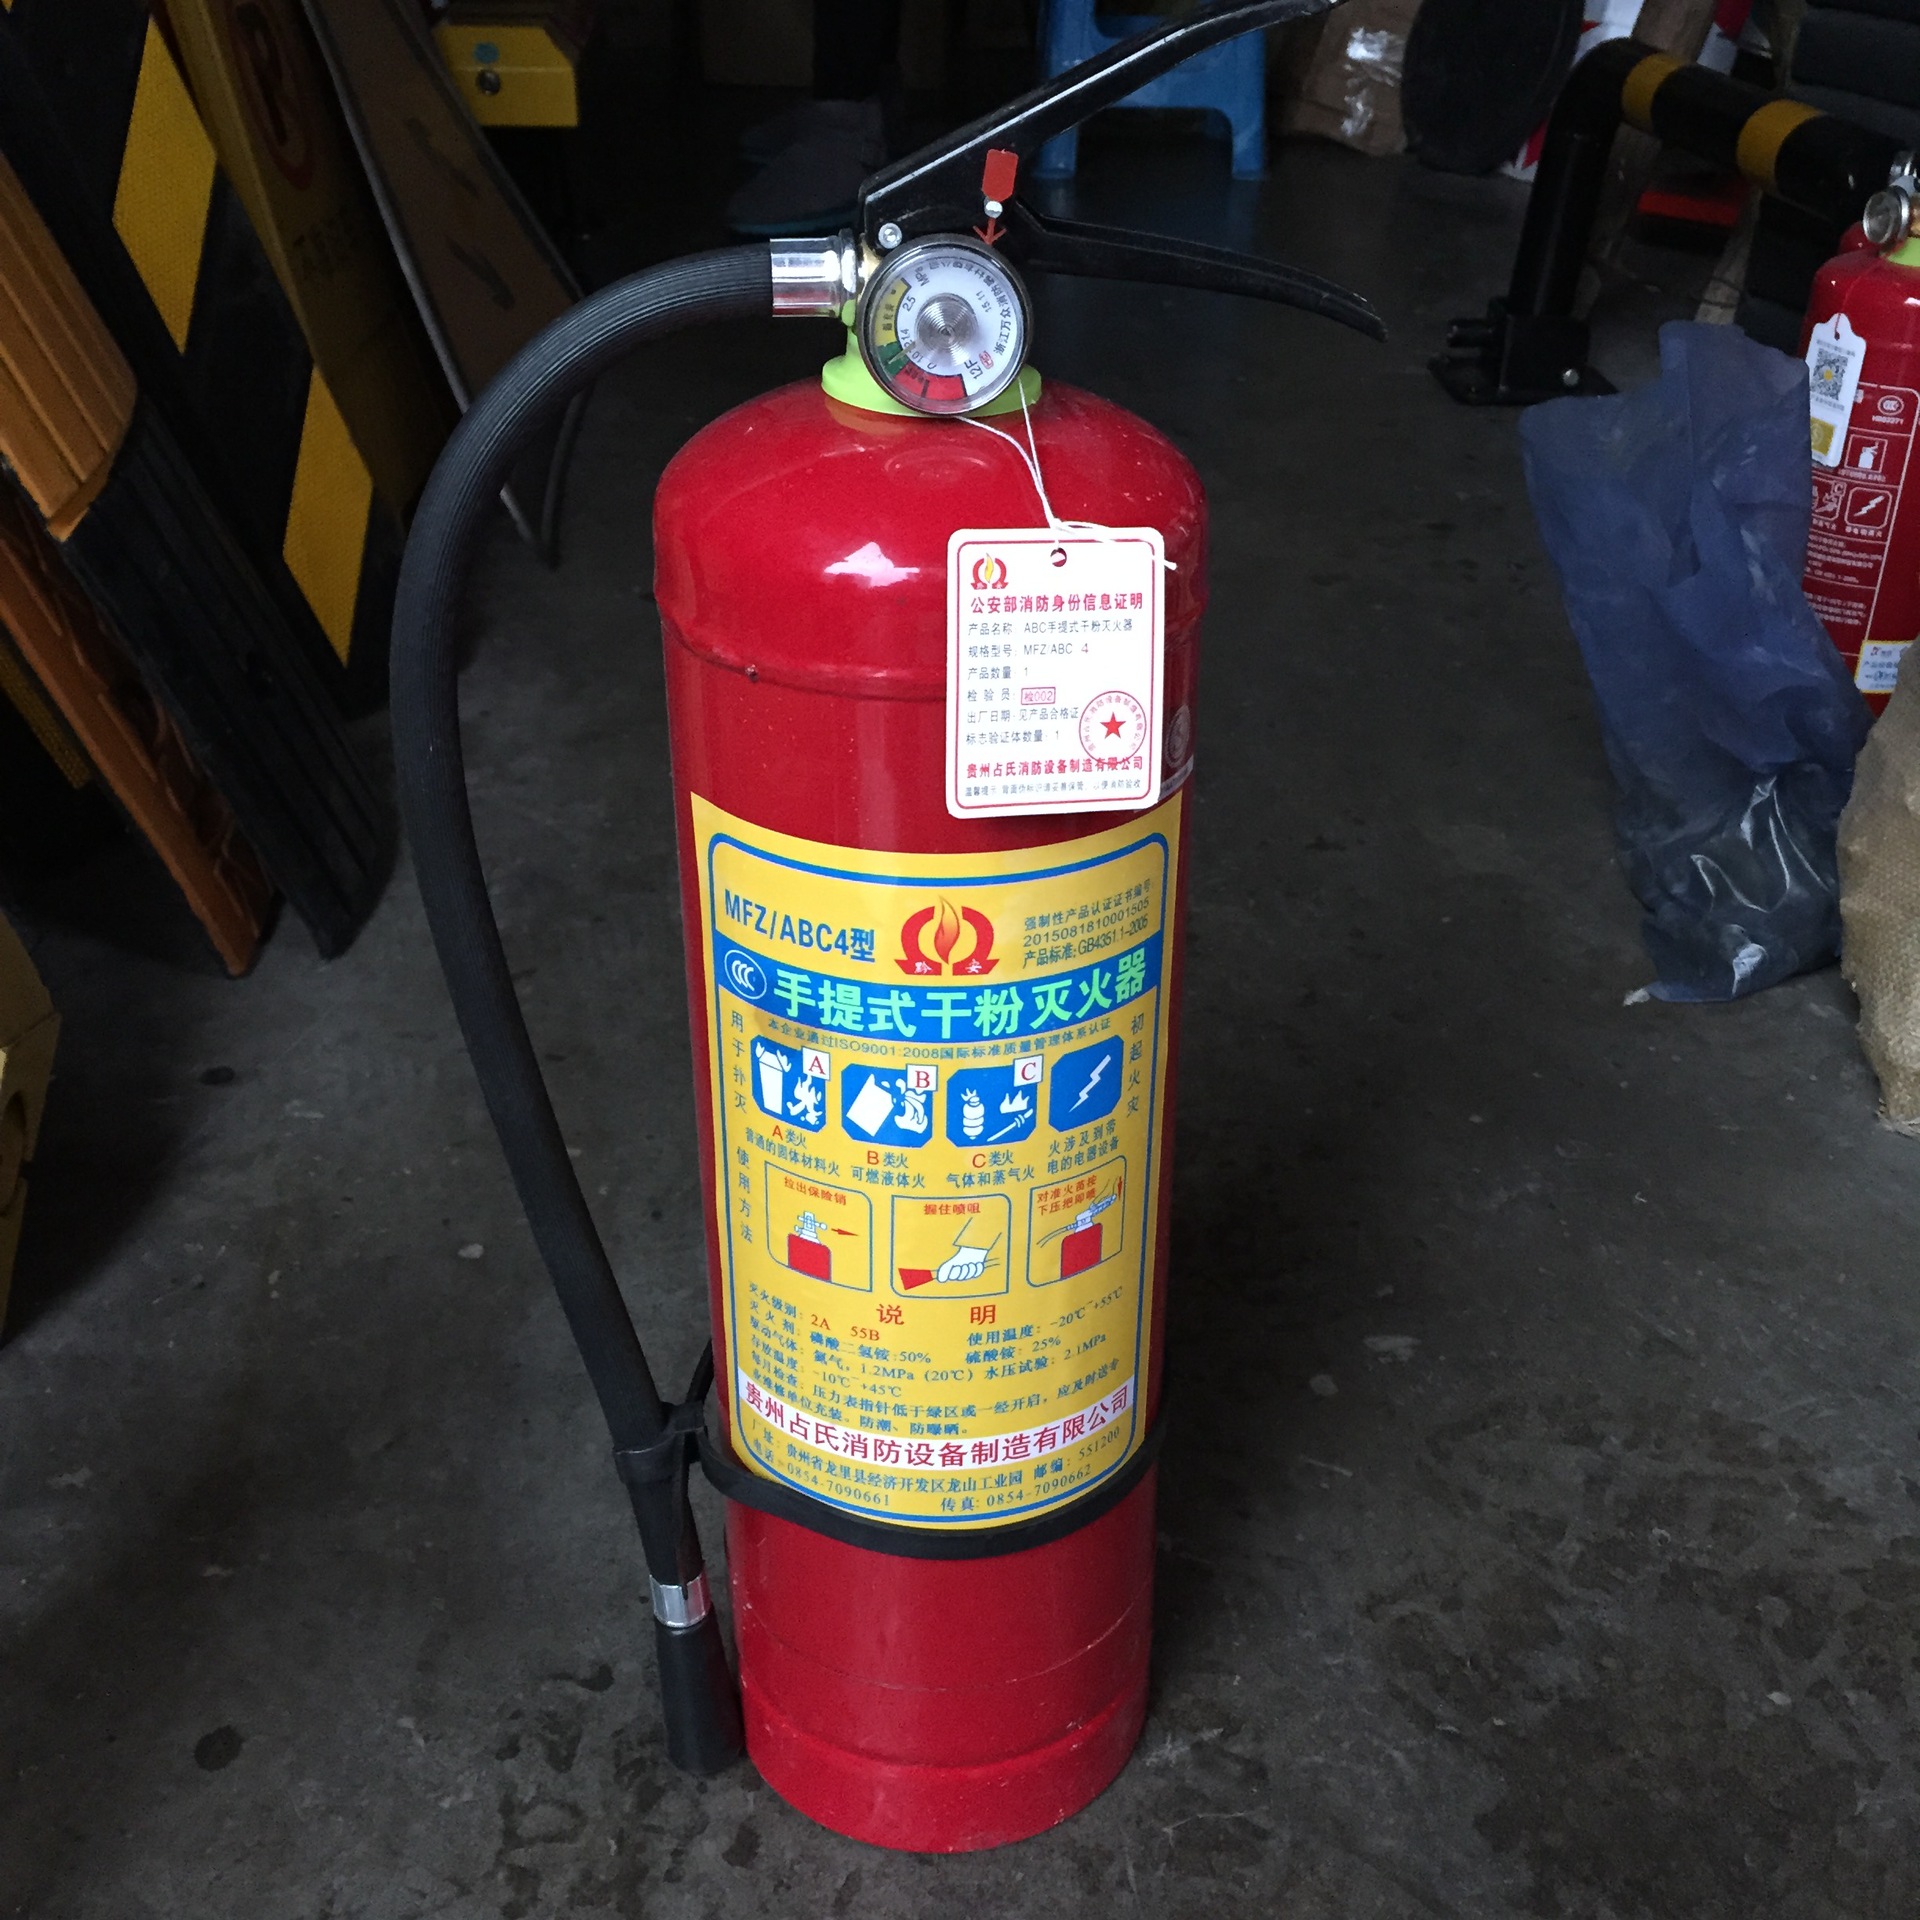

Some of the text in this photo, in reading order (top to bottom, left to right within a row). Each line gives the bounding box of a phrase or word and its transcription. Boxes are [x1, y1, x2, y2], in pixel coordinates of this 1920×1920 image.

[970, 592, 1143, 614] 公安部消防身份信息证明
[1024, 618, 1133, 634] ABC手提式干粉灭火器
[1081, 642, 1089, 654] 4
[1024, 667, 1029, 677] 1
[1055, 730, 1060, 740] 1
[966, 756, 1143, 779] 贵州占氏消防设备制造有限公司
[1024, 878, 1151, 931] 强制性产品认证证书编号
[724, 888, 876, 963] MFZ/ABC4型
[965, 958, 982, 974] 安
[773, 947, 1146, 1040] 手提式干粉灭火器
[731, 1010, 747, 1113] 用于扑灭
[808, 1055, 826, 1075] A
[1021, 1062, 1037, 1081] C
[1126, 1012, 1145, 1119] 初起火灾
[914, 1070, 931, 1088] B
[772, 1125, 808, 1149] A类火
[745, 1127, 840, 1177] 普通的固体材料火
[866, 1150, 909, 1169] B类火
[972, 1149, 1014, 1169] C类火
[1047, 1137, 1119, 1175] 电的电器设备
[851, 1165, 926, 1189] 可燃液体火
[946, 1165, 1035, 1190] 气体和蒸气火
[1037, 1174, 1097, 1203] 对准火苗按
[736, 1146, 752, 1243] 使用方法
[784, 1175, 847, 1206] 拉出保险销
[923, 1202, 981, 1216] 握住喷咀
[876, 1303, 997, 1326] 说 明
[811, 1314, 831, 1331] 2A
[850, 1325, 880, 1342] 55B
[1032, 1334, 1061, 1352] 25%
[745, 1380, 1128, 1467] 贵州占氏消防设备制造有限公司
[787, 1442, 1023, 1494] 贵州省龙里县经济开发区龙山工业园
[1078, 1426, 1120, 1461] 551200
[986, 1464, 1092, 1507] 0854-7090662
